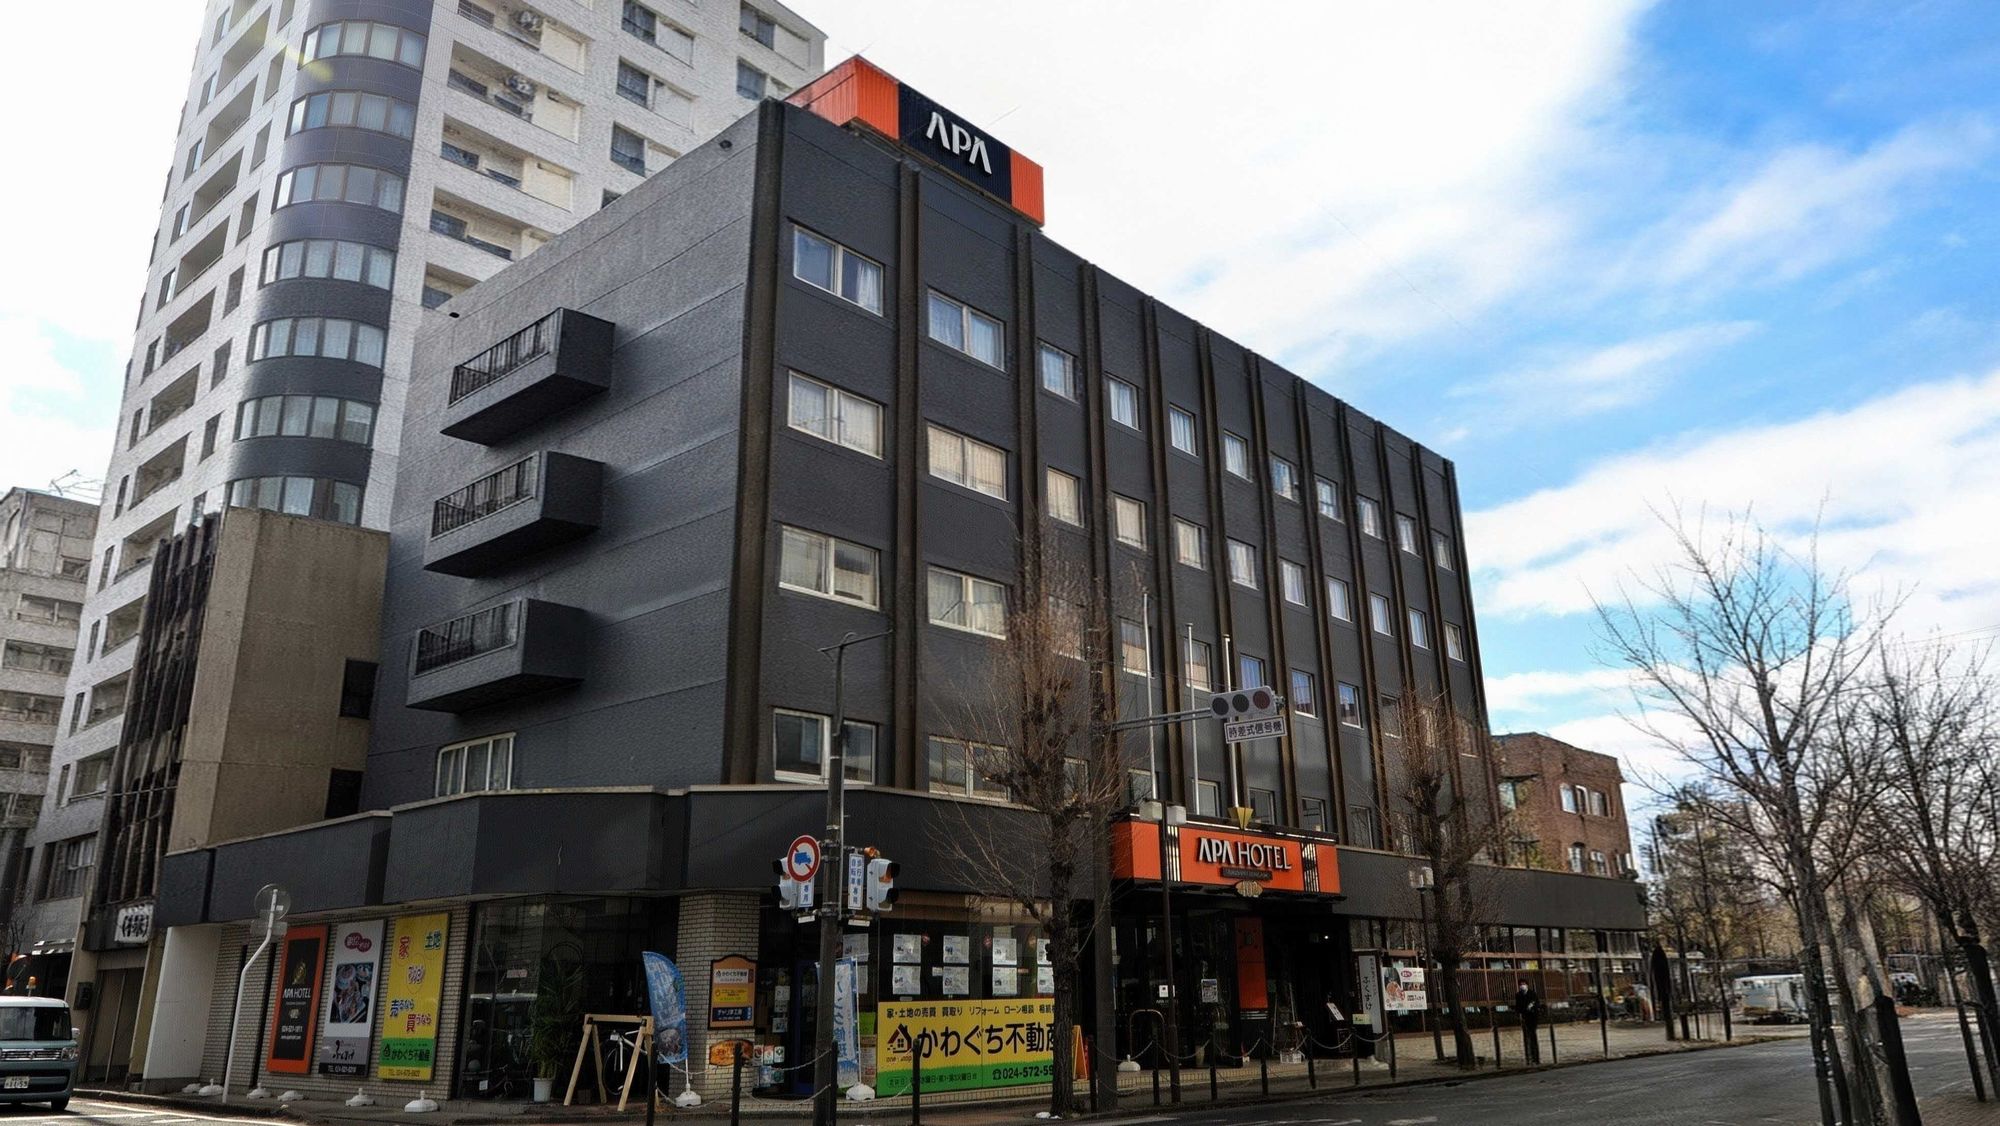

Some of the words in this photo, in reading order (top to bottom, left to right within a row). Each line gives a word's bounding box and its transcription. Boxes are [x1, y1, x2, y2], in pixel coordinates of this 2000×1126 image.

[926, 112, 992, 174] APA
[1229, 721, 1281, 738] 時差式信号機
[1199, 837, 1235, 864] APA
[1238, 841, 1292, 869] HOTEL
[399, 936, 410, 959] 家
[293, 988, 311, 998] HOTEL
[1363, 976, 1372, 1010] ふくすけ
[942, 1005, 963, 1017] 買取り
[969, 1005, 999, 1016] リフォーム
[1004, 1004, 1034, 1015] ローン相談
[1002, 1065, 1054, 1079] 024-572-59
